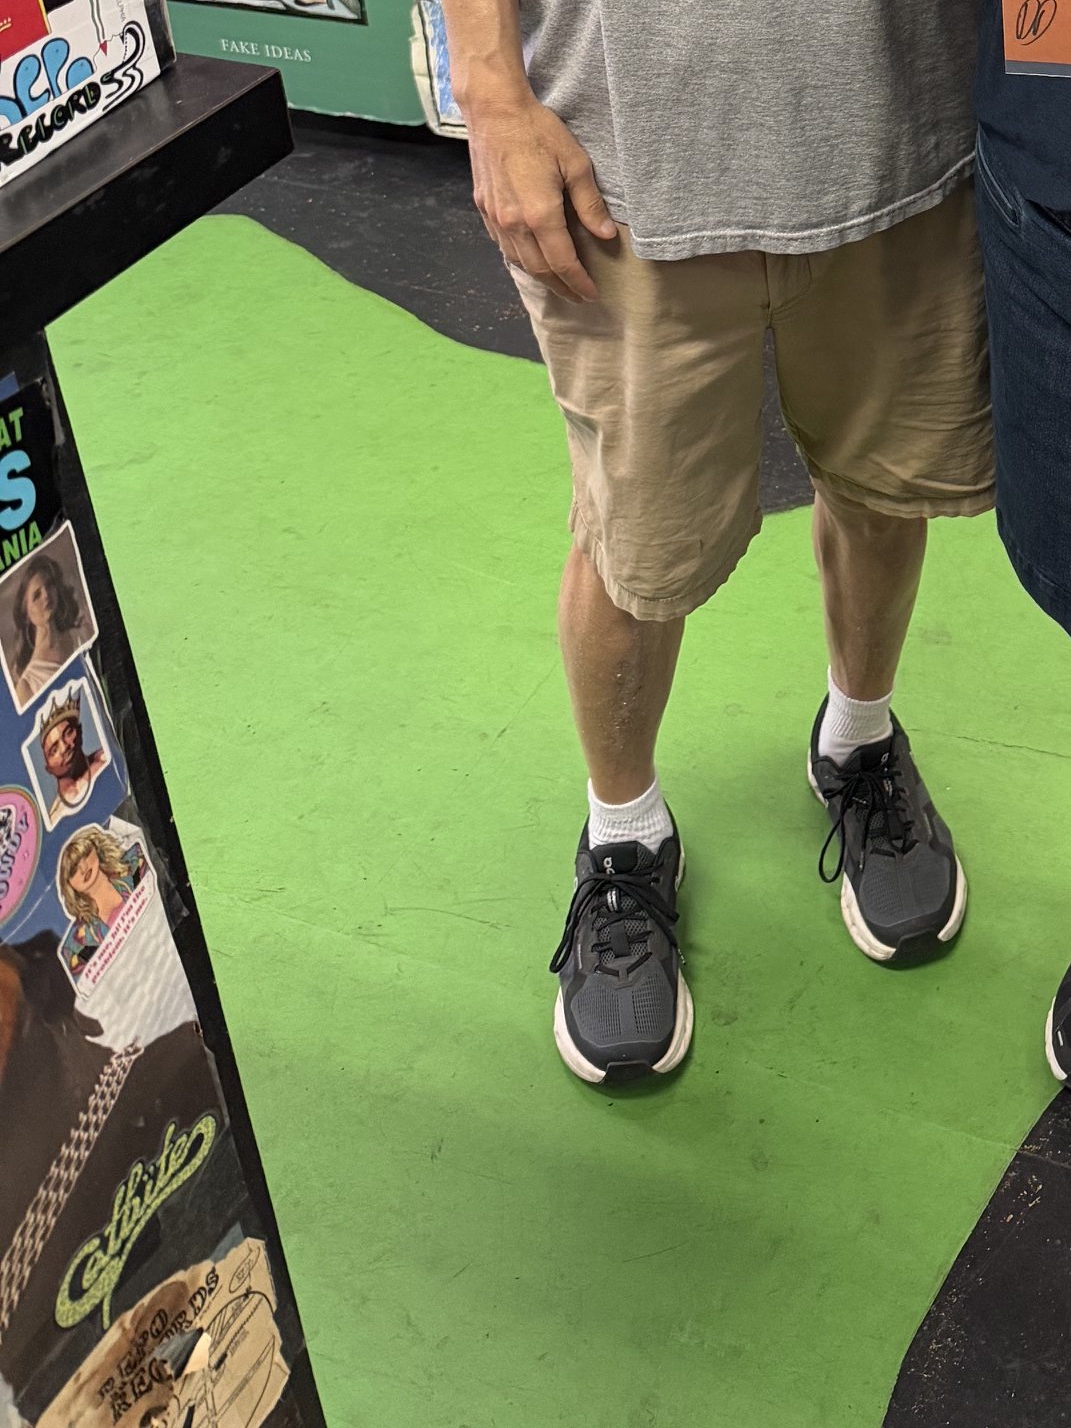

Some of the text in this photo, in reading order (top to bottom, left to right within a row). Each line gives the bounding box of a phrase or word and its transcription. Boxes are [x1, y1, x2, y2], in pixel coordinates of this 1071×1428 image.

[220, 38, 312, 64] FAKE IDEAS
[110, 1266, 220, 1427] RECRDS
